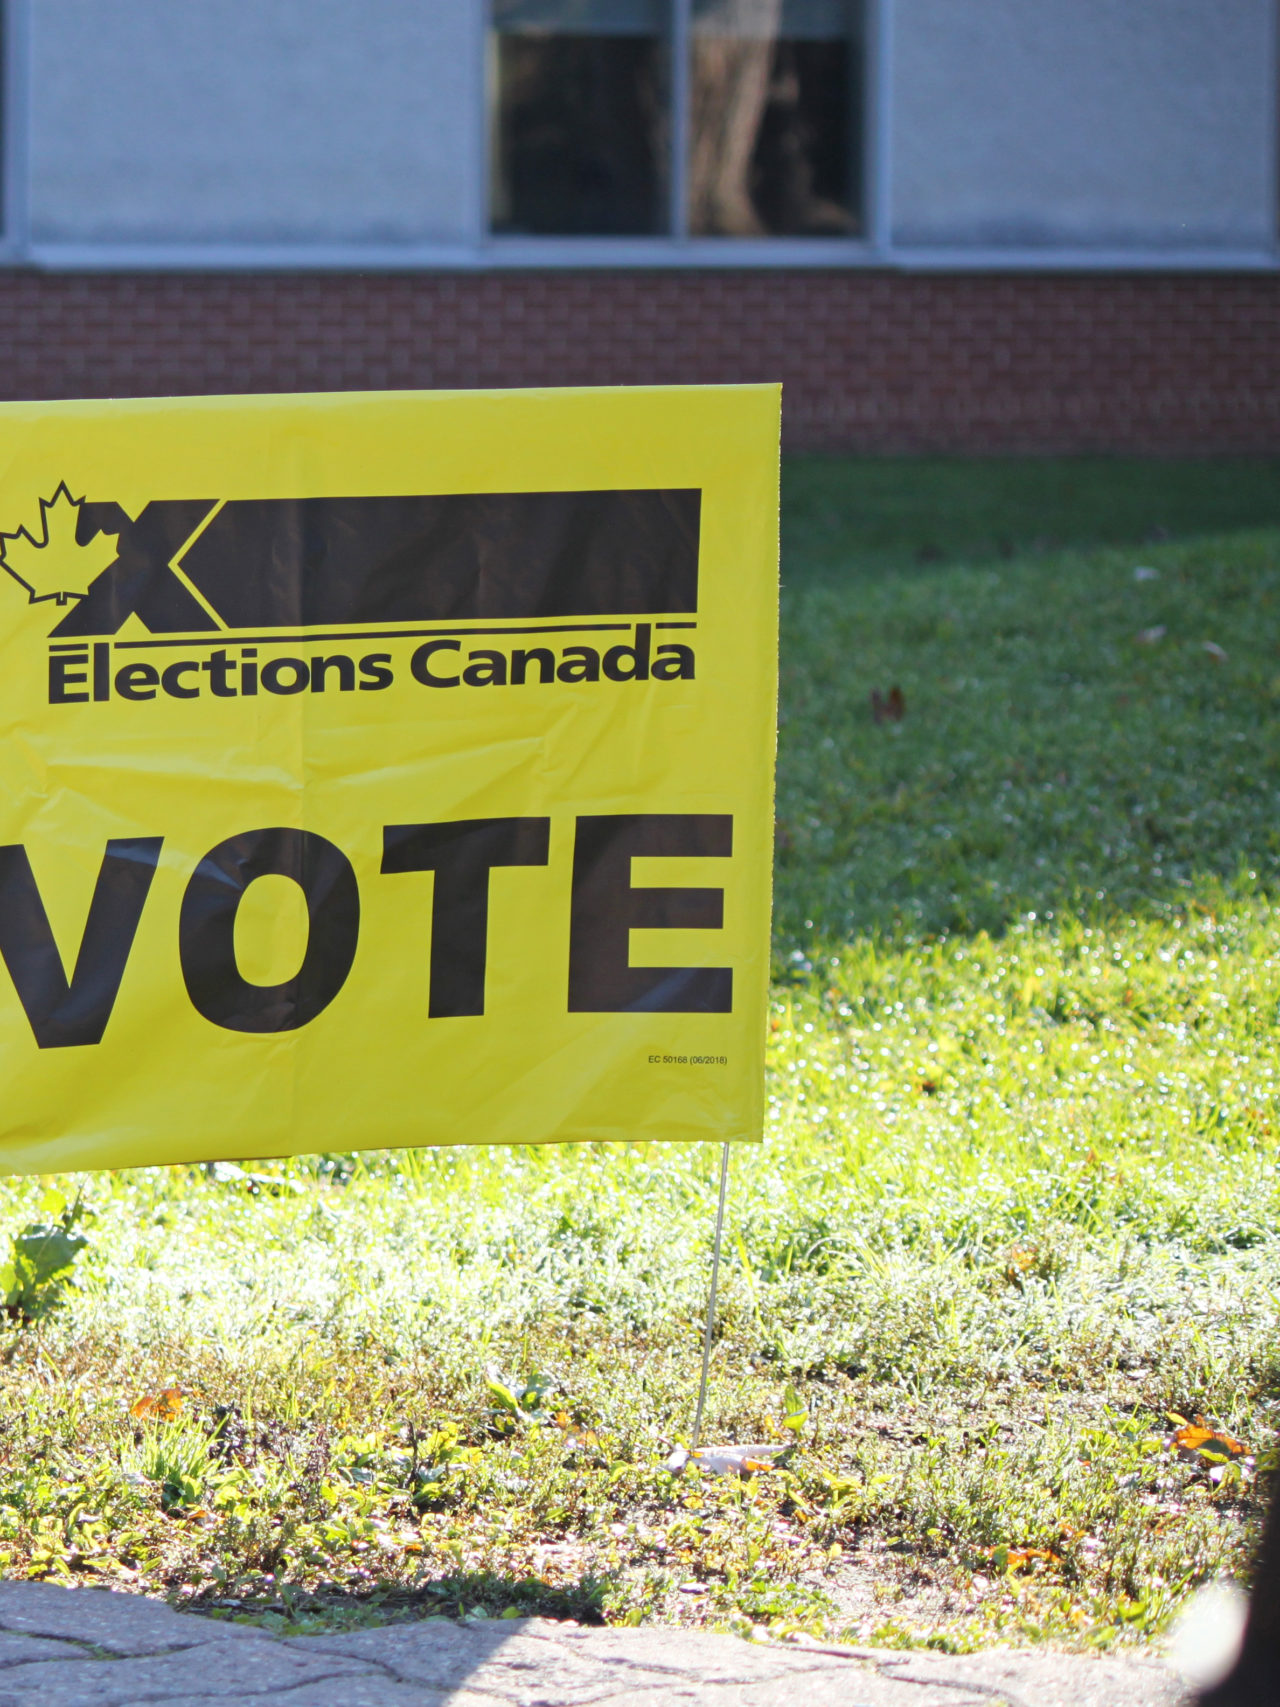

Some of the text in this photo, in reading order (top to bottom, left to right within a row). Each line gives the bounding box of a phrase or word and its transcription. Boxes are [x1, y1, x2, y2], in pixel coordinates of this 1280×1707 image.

[48, 624, 696, 704] Elections Canada
[648, 1055, 661, 1064] EC
